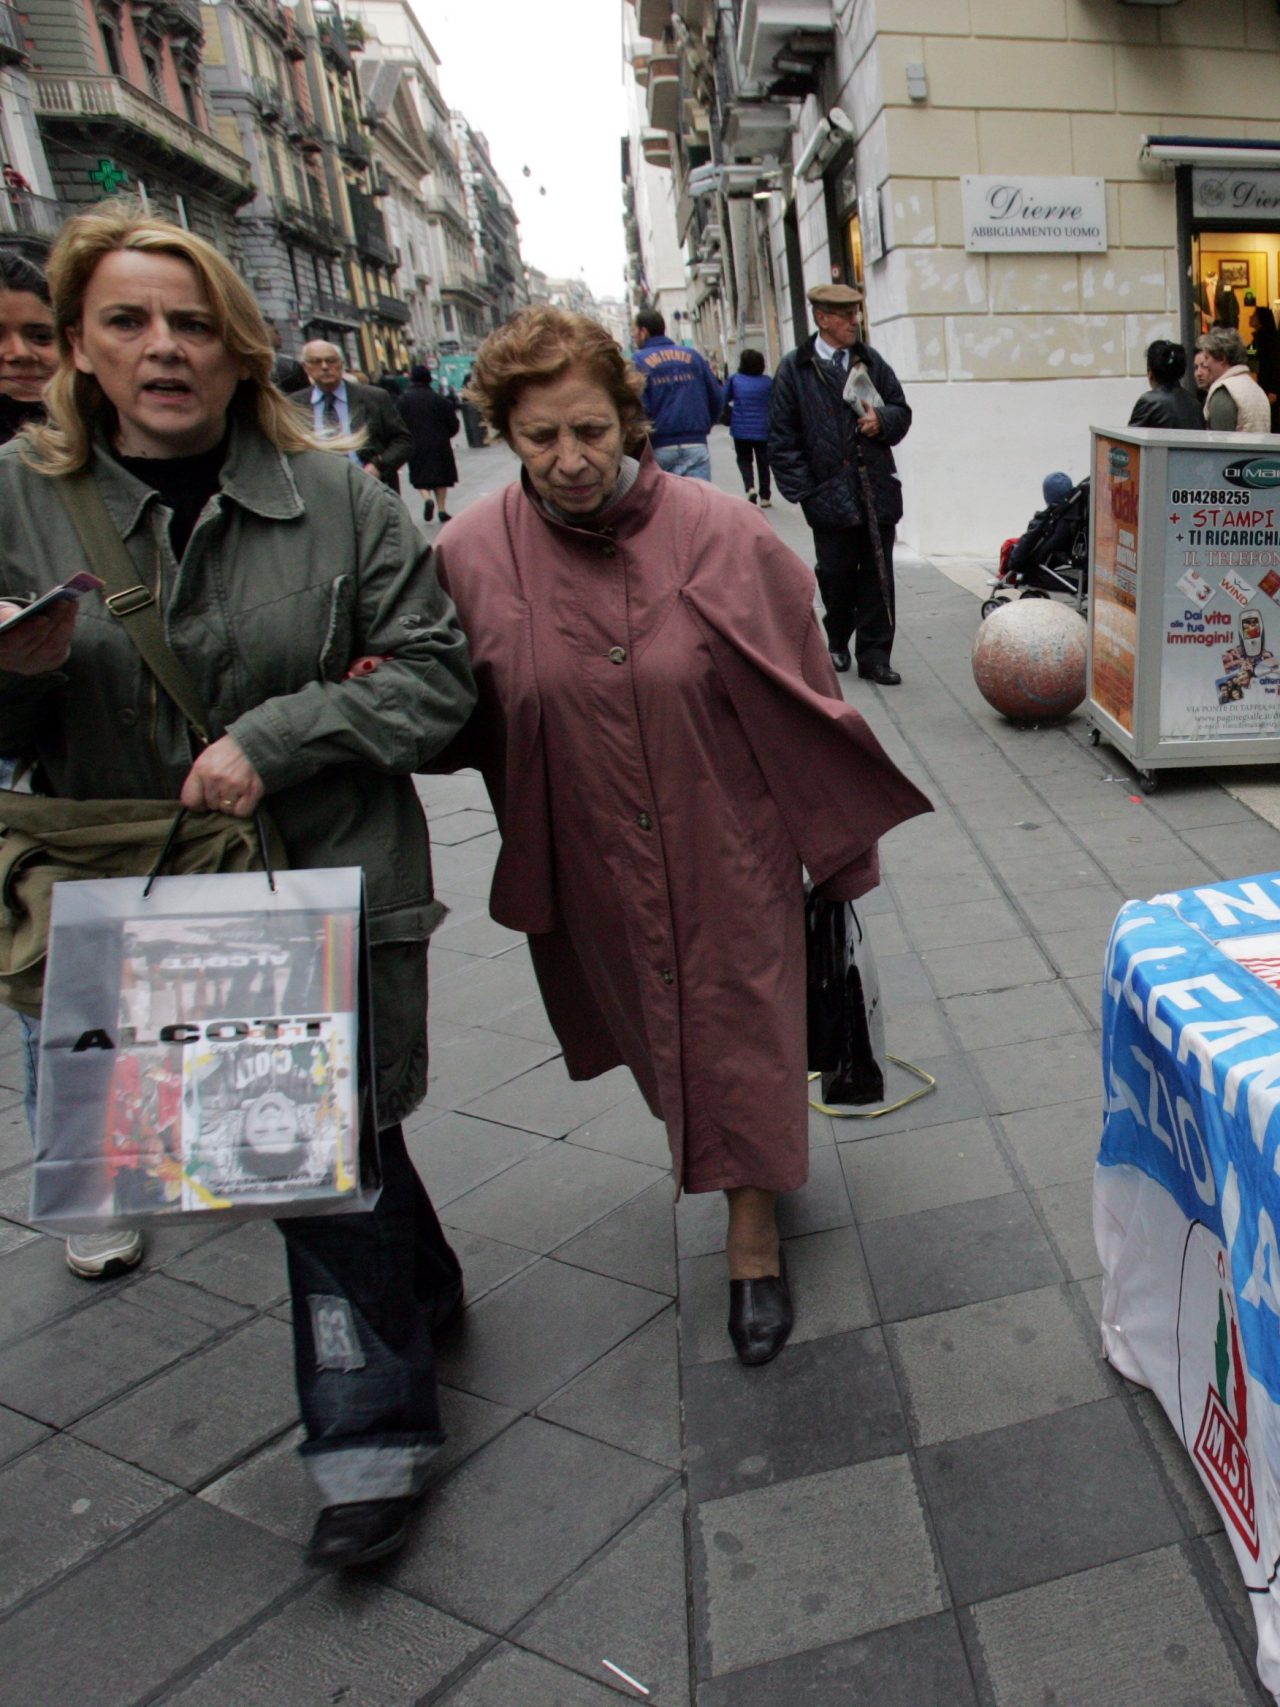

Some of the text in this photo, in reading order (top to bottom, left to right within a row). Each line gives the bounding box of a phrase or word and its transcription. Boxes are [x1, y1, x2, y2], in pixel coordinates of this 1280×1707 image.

[986, 184, 1083, 220] Dierre
[972, 226, 1100, 238] ABBIGLIAMENTO UOMO
[1224, 467, 1241, 478] DI
[1171, 489, 1250, 505] 0814288255
[1193, 509, 1274, 528] STAMPI
[1189, 530, 1201, 545] TI
[1183, 551, 1200, 566] IL
[1220, 578, 1249, 607] WIND
[1184, 609, 1232, 625] Dai vita
[1187, 622, 1205, 632] tue
[1167, 632, 1234, 647] immagini!
[1206, 1413, 1254, 1522] M.S.I.
